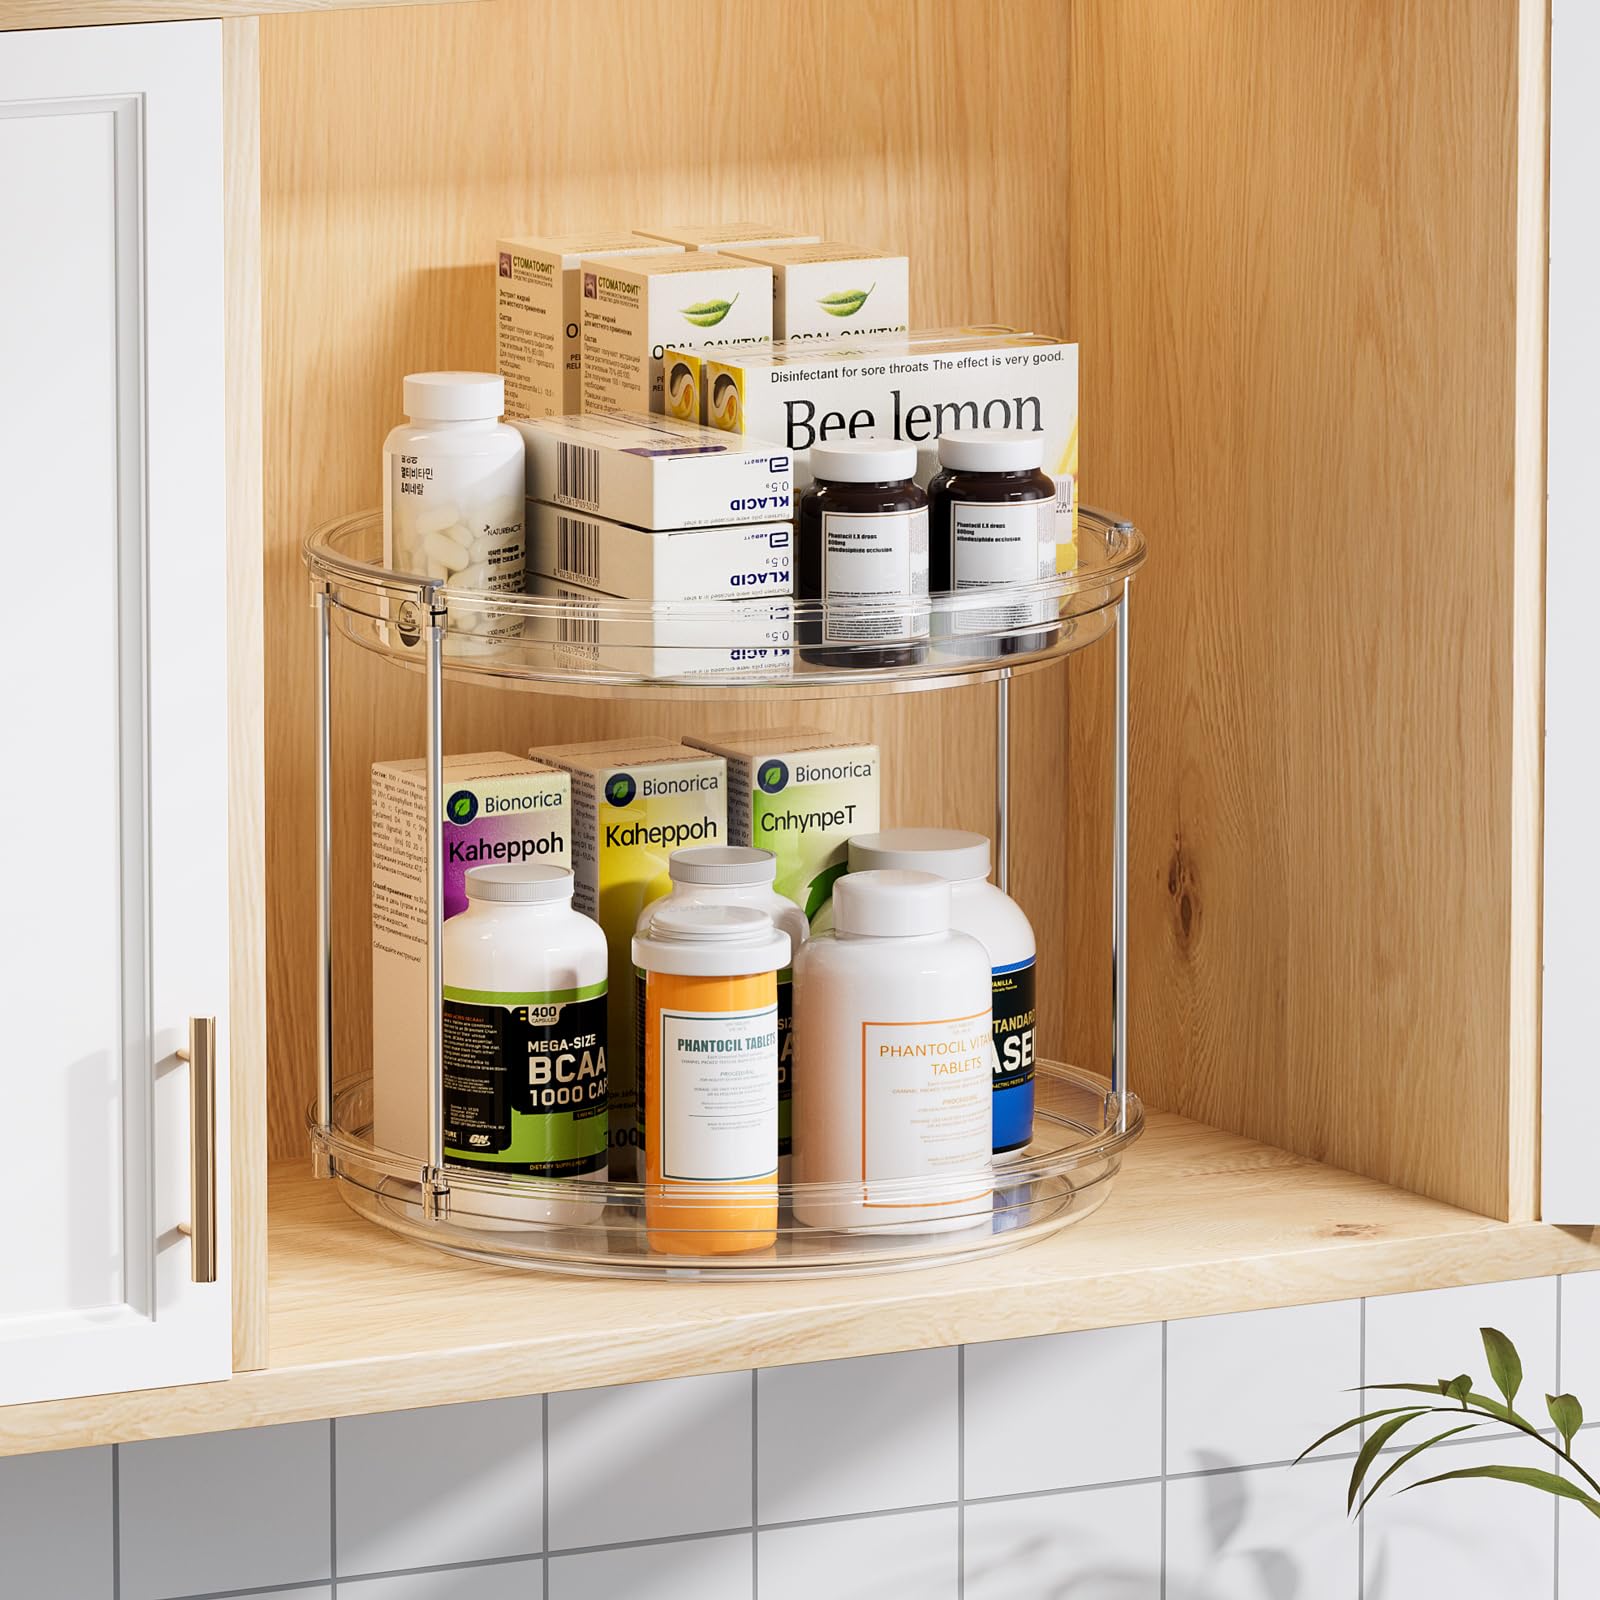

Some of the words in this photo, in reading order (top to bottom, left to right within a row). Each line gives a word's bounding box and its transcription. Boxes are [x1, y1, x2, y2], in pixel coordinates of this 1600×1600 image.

[598, 276, 639, 296] СТОМАТОФИТ
[771, 368, 838, 383] Disinfectant
[842, 366, 858, 378] for
[861, 364, 886, 377] sore
[889, 361, 929, 374] throats
[933, 359, 953, 371] The
[957, 356, 989, 369] effect
[992, 355, 1001, 367] is
[1005, 355, 1030, 367] very
[1032, 350, 1065, 366] good.
[783, 399, 875, 450] Bee
[890, 389, 1044, 441] lemon
[730, 495, 790, 511] KLACID
[730, 570, 790, 587] KLACID
[796, 761, 872, 783] Bionorica
[643, 774, 719, 796] Bionorica
[485, 790, 562, 813] Bionorica
[761, 804, 857, 834] CnhynpeT
[606, 815, 717, 848] Kaheppoh
[449, 831, 564, 863] Kaheppoh
[531, 1006, 557, 1018] 400
[527, 1033, 597, 1053] MEGA-SIZE
[677, 1038, 743, 1053] PHANTOCIL
[745, 1031, 776, 1051] TABLETS
[879, 1040, 967, 1057] PHANTOCIL
[529, 1046, 607, 1085] BCAA
[930, 1056, 982, 1076] TABLETS
[530, 1085, 583, 1107] 1000
